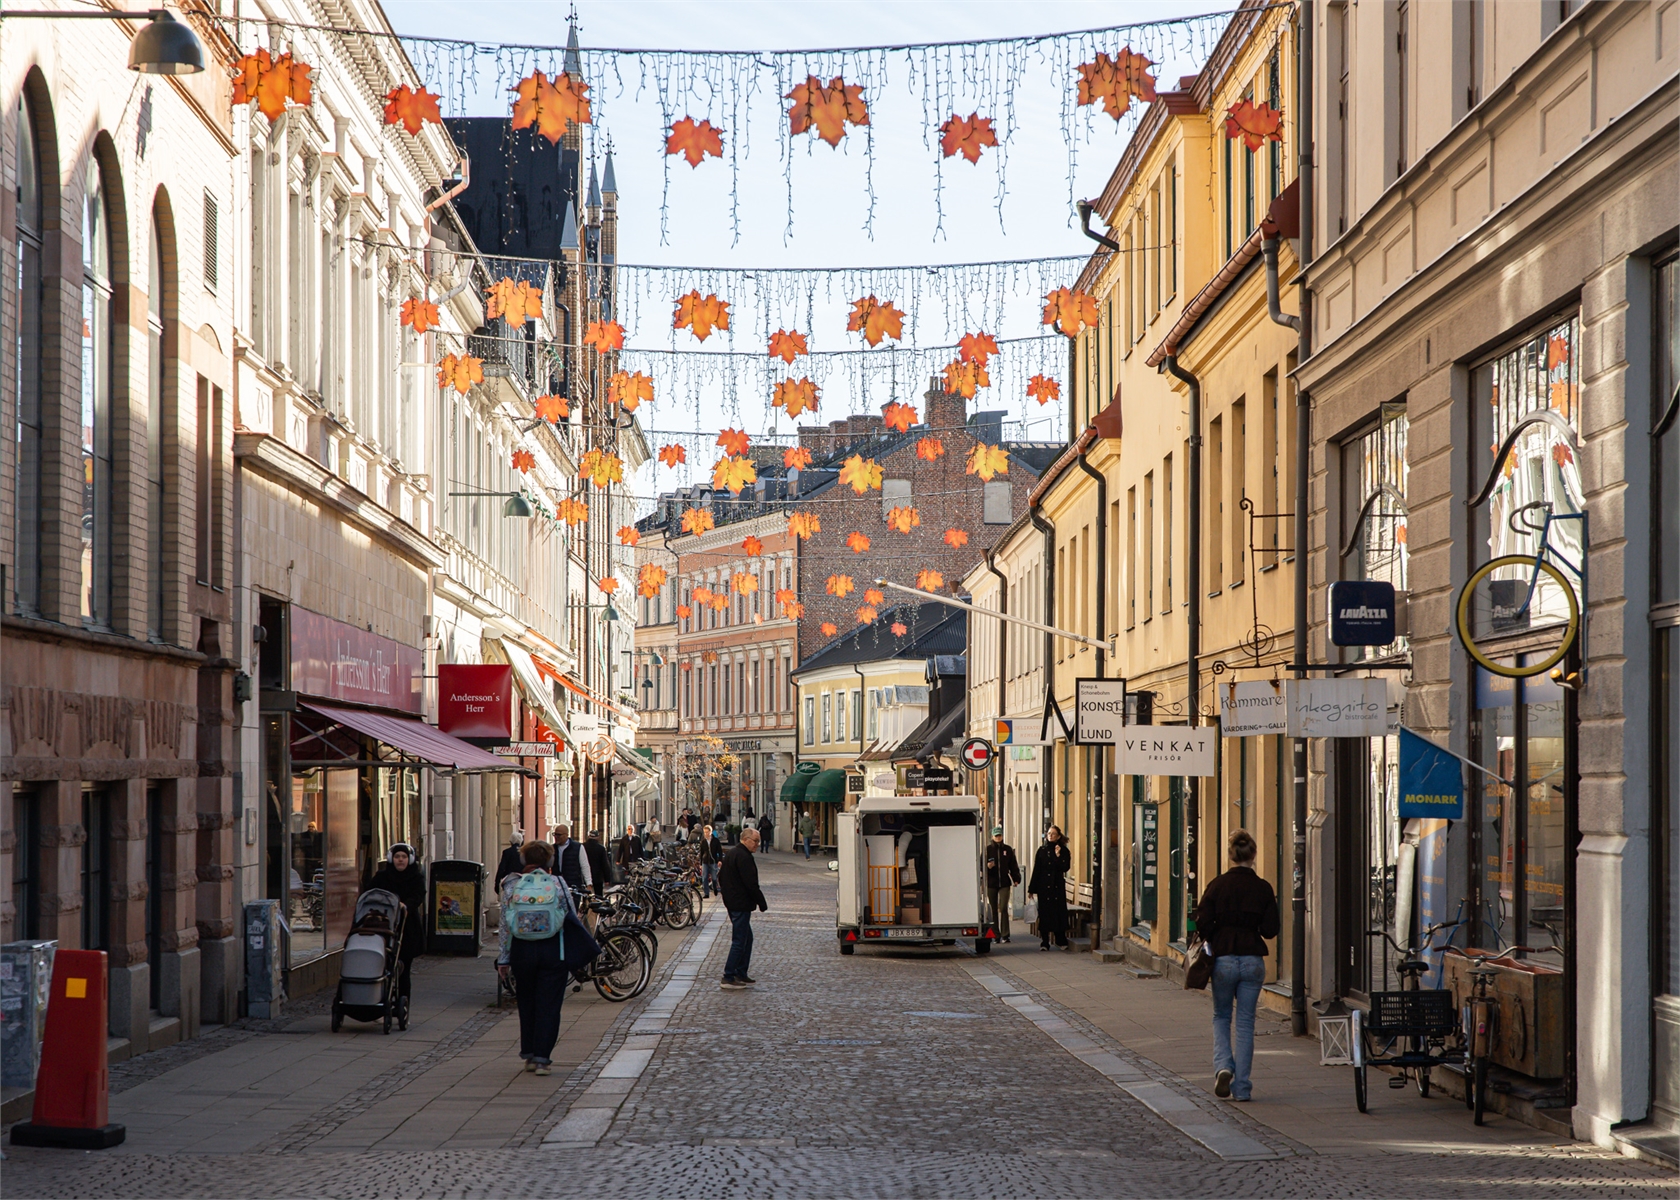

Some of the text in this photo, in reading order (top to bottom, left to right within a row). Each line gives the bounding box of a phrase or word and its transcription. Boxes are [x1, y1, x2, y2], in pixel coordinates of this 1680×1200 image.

[1339, 605, 1388, 619] LAVAZZA
[376, 650, 391, 695] Herr
[1080, 701, 1120, 712] KONST
[1220, 695, 1286, 710] Kammare
[1295, 693, 1379, 722] inkognito
[465, 704, 485, 713] Herr
[1345, 713, 1378, 721] bistrocafé
[572, 724, 596, 732] Glitter
[1223, 723, 1258, 733] VÄRDERING
[1080, 729, 1113, 739] LUND
[525, 743, 553, 756] Nails
[1125, 740, 1205, 752] VENKAT
[1404, 794, 1458, 805] MONARK
